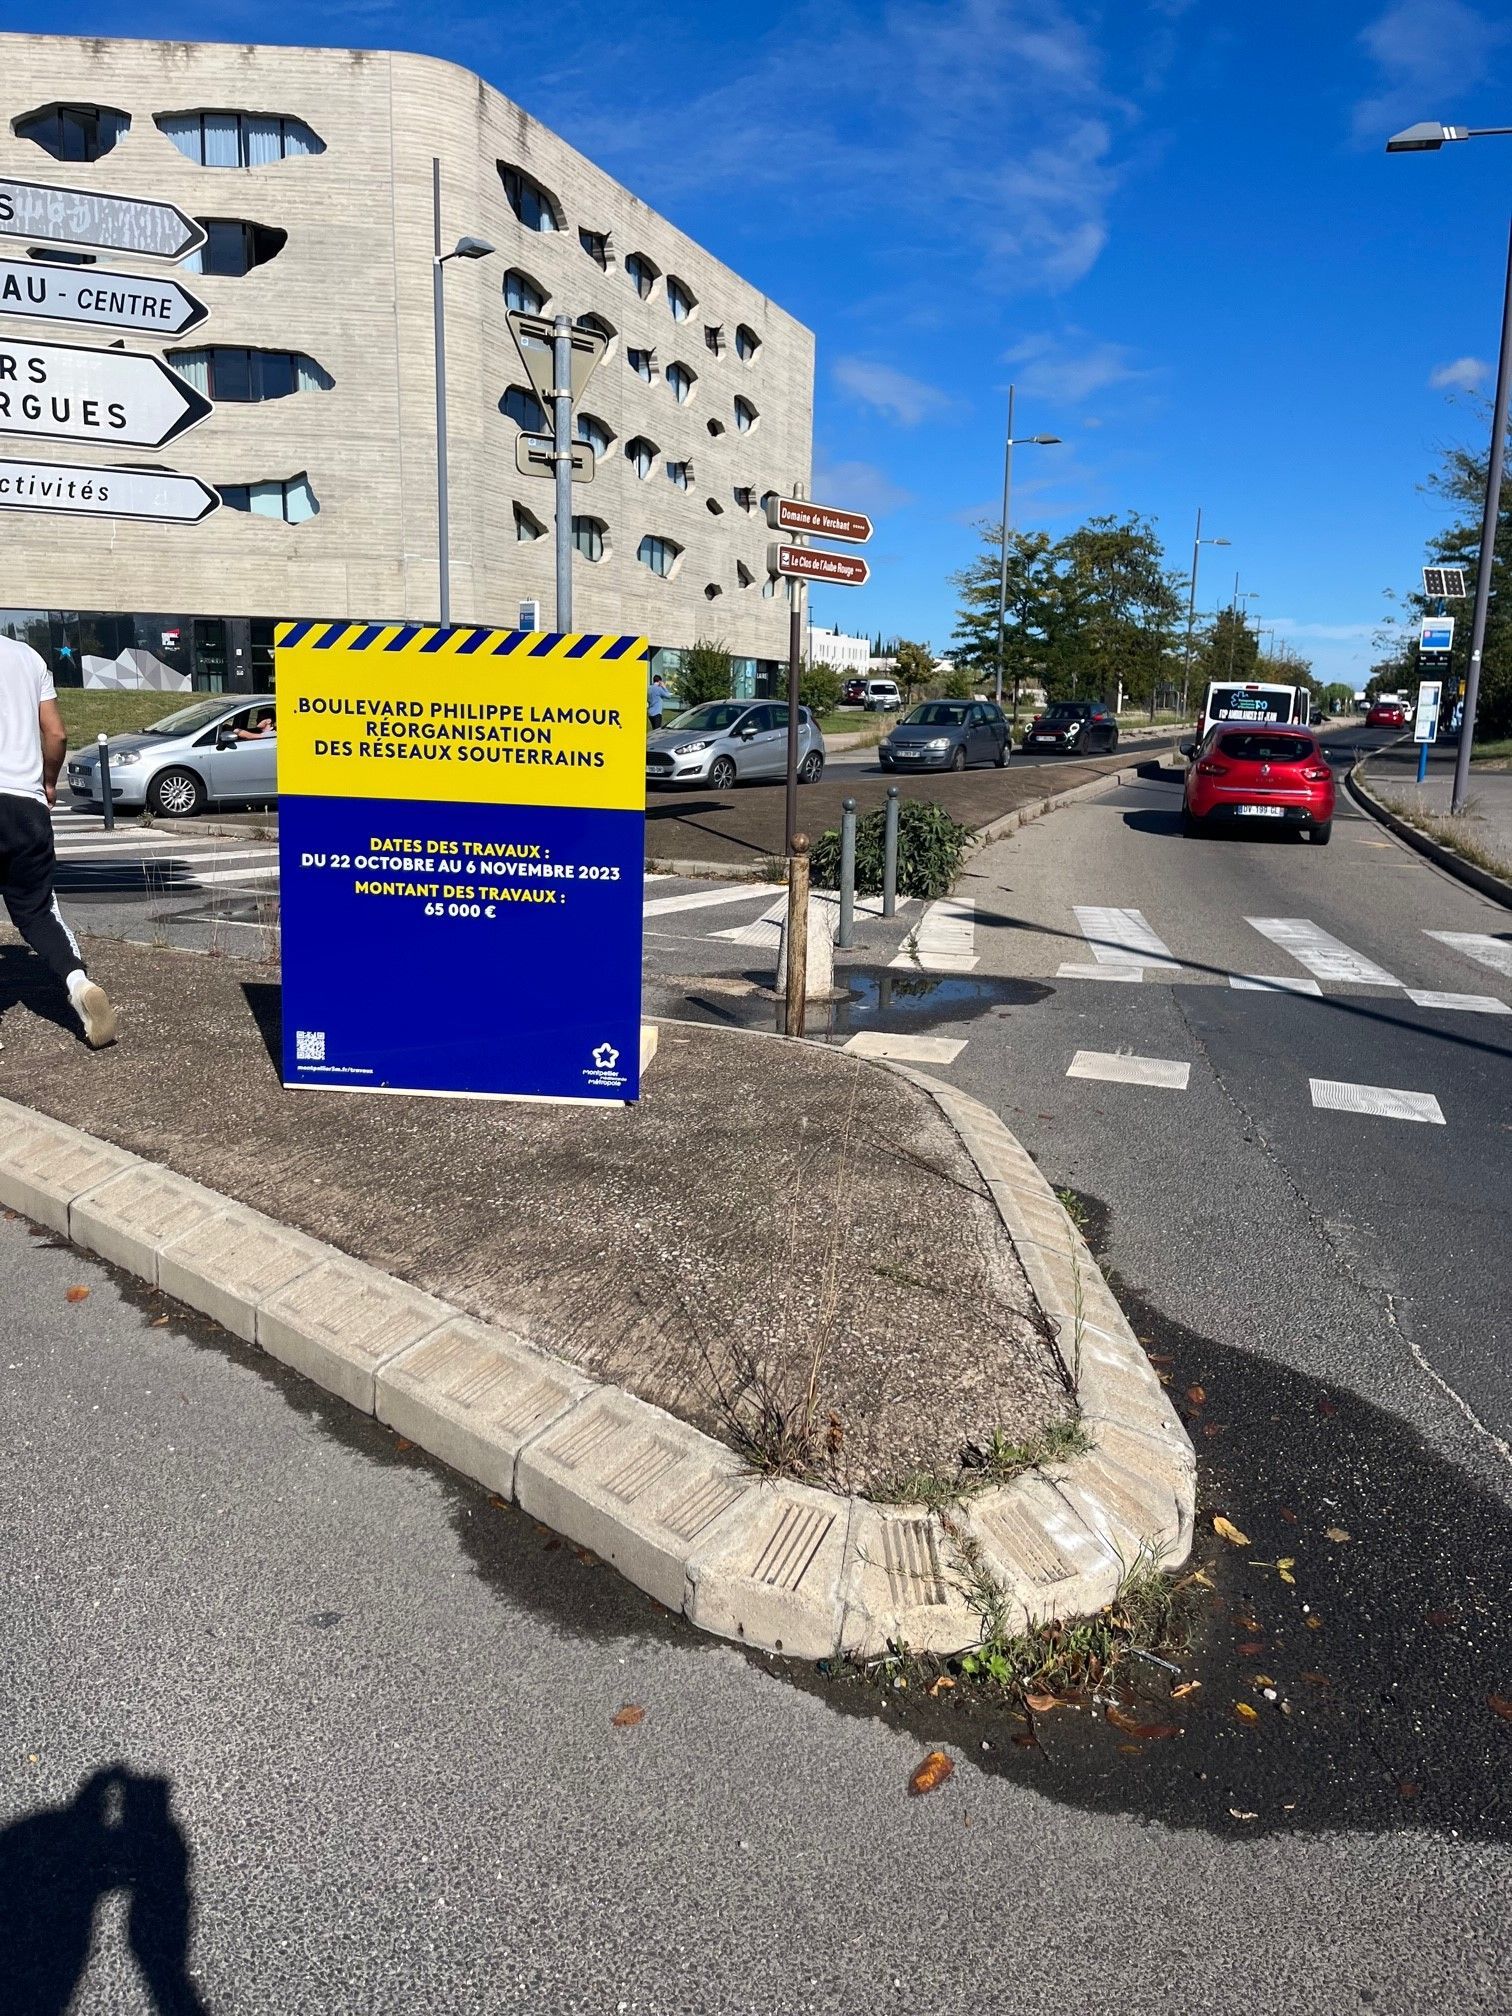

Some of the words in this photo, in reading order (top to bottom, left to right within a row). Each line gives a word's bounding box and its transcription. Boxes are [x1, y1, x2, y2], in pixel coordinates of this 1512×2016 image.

[2, 273, 46, 304] AU
[77, 288, 172, 320] CENTRE
[0, 354, 47, 384] RS
[0, 476, 109, 502] ctivités
[781, 507, 811, 522] Domaine
[812, 514, 820, 525] de
[822, 515, 850, 531] Verchant
[791, 555, 799, 566] Le
[799, 555, 812, 568] Clos
[812, 558, 820, 569] de
[837, 562, 854, 577] Rouge
[298, 697, 424, 718] BOULEVARD
[430, 702, 524, 722] PHILIPPE
[530, 706, 620, 725] LAMOUR
[366, 717, 551, 744] RÉORGANISATION
[314, 739, 353, 757] DES
[359, 737, 452, 761] RÉSEAUX
[457, 745, 605, 768] SOUTERRAINS
[370, 837, 423, 853] DATES
[426, 840, 459, 855] DES
[461, 841, 541, 859] TRAVAUX
[544, 849, 550, 859] :
[301, 852, 327, 868] DU
[330, 854, 351, 869] 22
[354, 855, 435, 872] OCTOBRE
[437, 859, 462, 874] AU
[465, 860, 477, 874] 6
[480, 860, 575, 879] NOVEMBRE
[578, 865, 621, 881] 2023
[355, 880, 440, 898] MONTANT
[443, 884, 475, 900] DES
[478, 886, 557, 904] TRAVAUX
[560, 893, 566, 904] :
[424, 902, 445, 917] 65
[448, 903, 481, 918] 000
[484, 904, 497, 919] €
[582, 1069, 619, 1077] Montpellier
